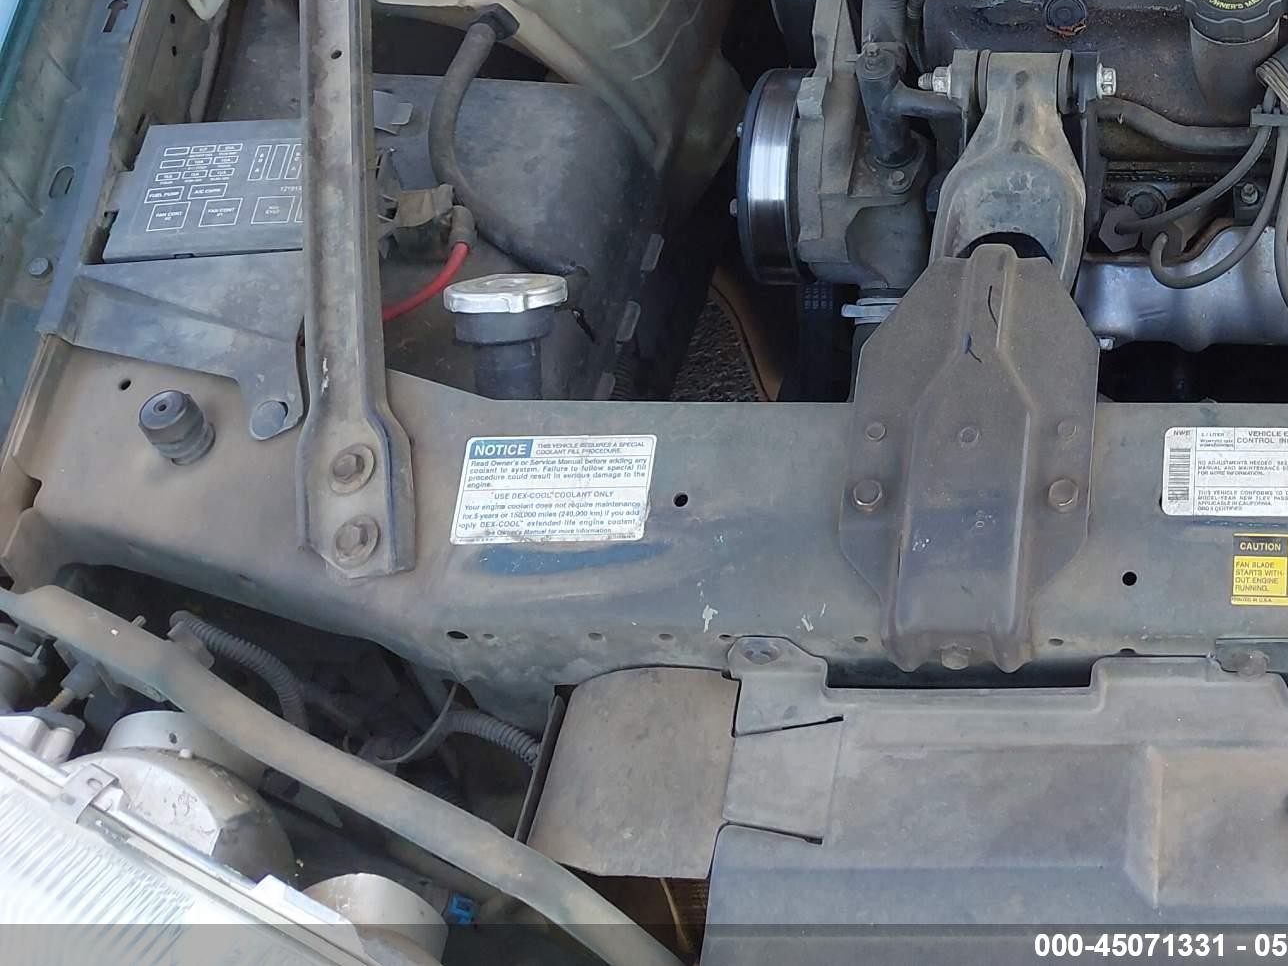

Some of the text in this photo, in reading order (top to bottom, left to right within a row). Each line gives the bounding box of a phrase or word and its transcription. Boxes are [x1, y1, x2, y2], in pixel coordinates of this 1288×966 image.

[474, 443, 528, 456] NOTICE
[608, 457, 632, 466] adding
[607, 464, 634, 472] special
[592, 472, 621, 480] damage
[593, 490, 614, 498] ONLY
[481, 503, 506, 512] engine
[568, 501, 593, 509] require
[480, 513, 498, 521] years
[610, 510, 624, 518] you
[1239, 542, 1281, 551] CAUTION
[1251, 561, 1275, 569] BLADE
